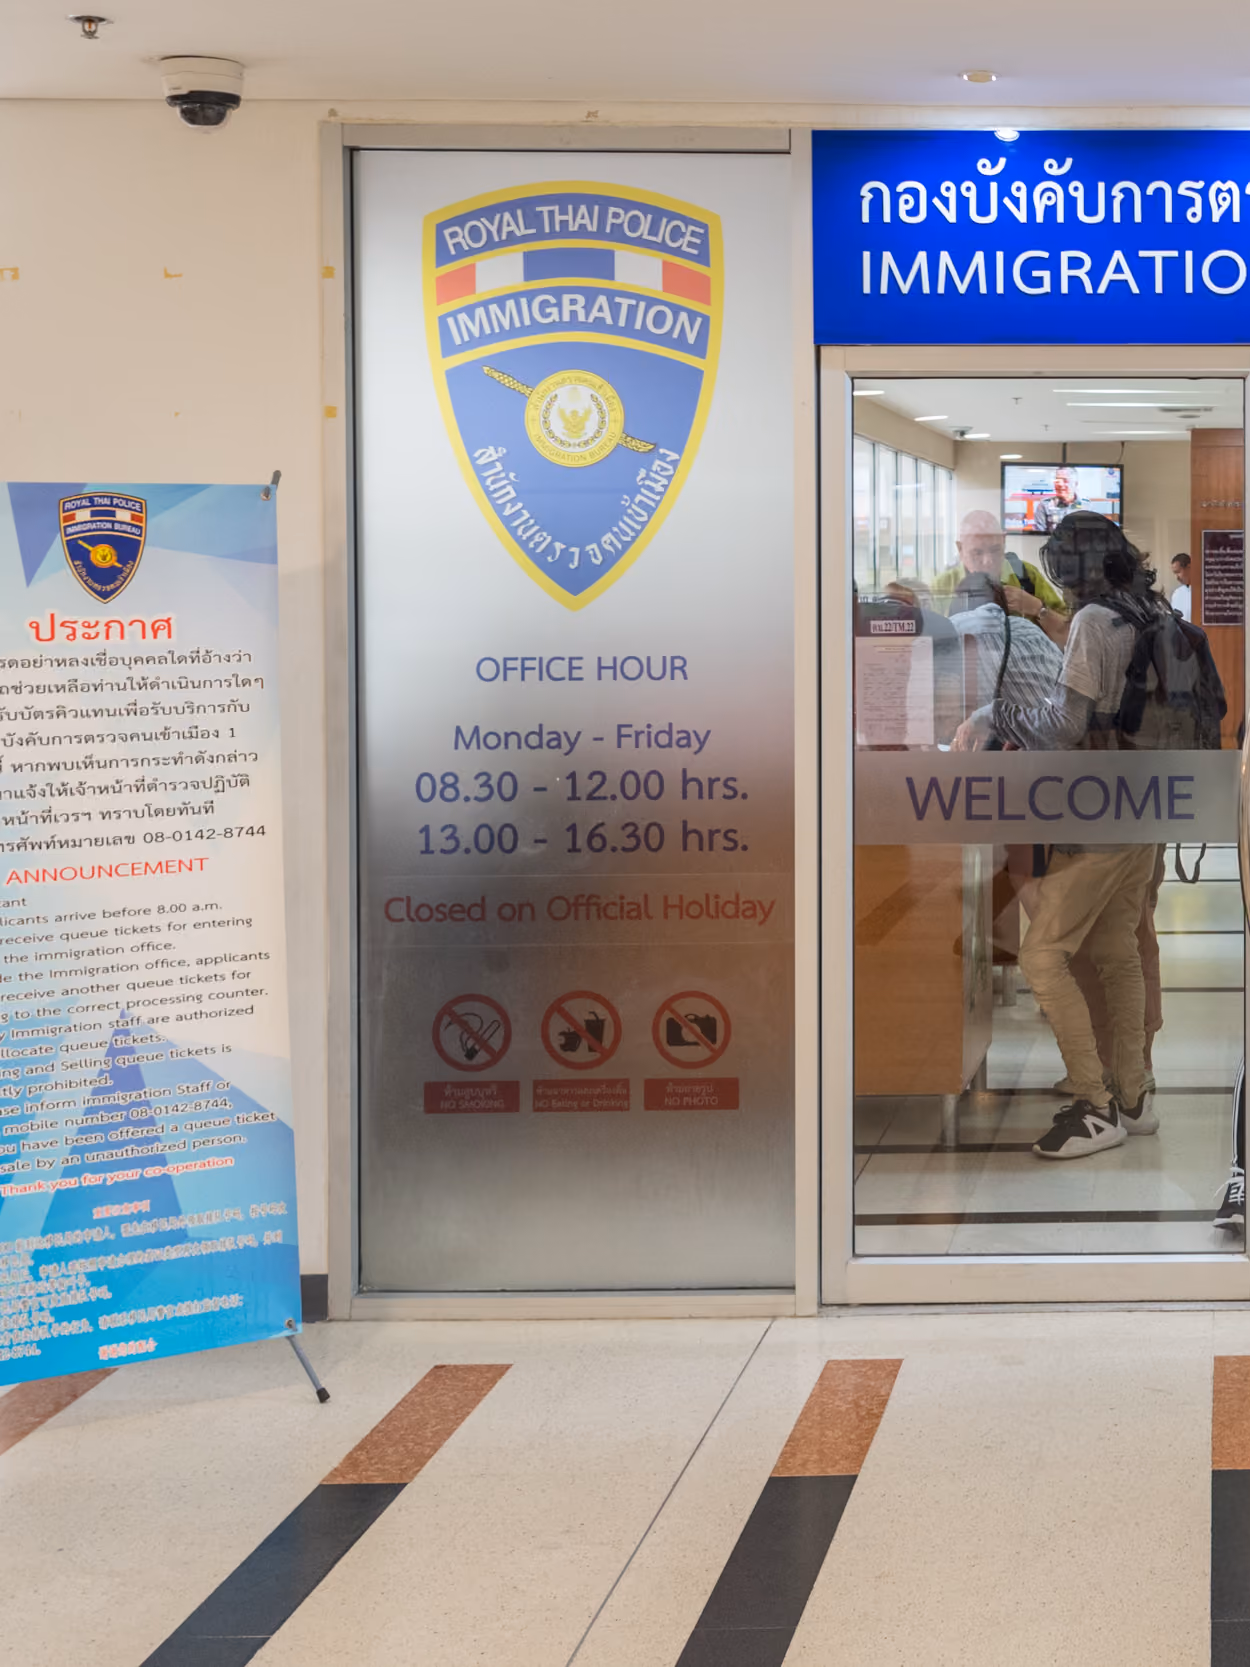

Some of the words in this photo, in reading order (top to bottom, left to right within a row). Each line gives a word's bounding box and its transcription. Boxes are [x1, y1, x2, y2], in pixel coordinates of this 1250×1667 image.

[443, 206, 537, 255] ROYAL
[535, 204, 598, 232] THAI
[605, 205, 705, 255] POLICE
[446, 293, 703, 345] IMMIGRATION
[64, 498, 91, 511] ROYAL
[93, 496, 111, 505] THAI
[113, 498, 141, 511] POLICE
[29, 613, 174, 643] ประกาศ
[475, 656, 585, 683] OFFICE
[596, 655, 689, 682] HOUR
[228, 727, 236, 738] 1
[454, 724, 582, 756] Monday
[616, 723, 712, 755] Friday
[11, 750, 259, 774] หากพบเห็นการกระทำดังกล่าว
[415, 771, 519, 803] 08.30
[565, 769, 665, 801] 12.00
[681, 767, 749, 801] hrs.
[906, 775, 1195, 821] WELCOME
[99, 800, 215, 821] ทราบโดยทันที
[143, 825, 266, 844] 08-0142-8744
[418, 823, 519, 855] 13.00
[565, 821, 665, 853] 16.30
[681, 819, 749, 853] hrs.
[5, 857, 209, 885] ANNOUNCEMENT
[385, 896, 487, 923] Closed
[497, 902, 536, 922] on
[547, 893, 654, 922] Official
[662, 893, 777, 925] Holiday
[60, 928, 109, 943] queue
[114, 923, 162, 937] tickets
[167, 920, 188, 932] for
[193, 916, 253, 930] entering
[4, 953, 29, 964] the
[34, 945, 125, 963] immigration
[130, 940, 176, 952] office.
[1, 989, 56, 1001] receive
[61, 983, 121, 996] another
[126, 979, 174, 992] queue
[179, 973, 227, 986] tickets
[231, 969, 251, 981] for
[460, 1099, 505, 1110] SMOKING
[665, 1096, 681, 1107] NO
[683, 1095, 719, 1107] PHOTO
[4, 1119, 59, 1135] mobile
[65, 1112, 126, 1127] number
[0, 1160, 31, 1174] sale
[36, 1157, 56, 1170] by
[60, 1155, 80, 1166] an
[86, 1141, 187, 1162] unauthorized
[192, 1134, 247, 1150] person.
[1, 1179, 46, 1196] Thank
[50, 1177, 78, 1192] you
[82, 1172, 103, 1186] for
[107, 1168, 141, 1184] your
[144, 1157, 234, 1178] co-operation
